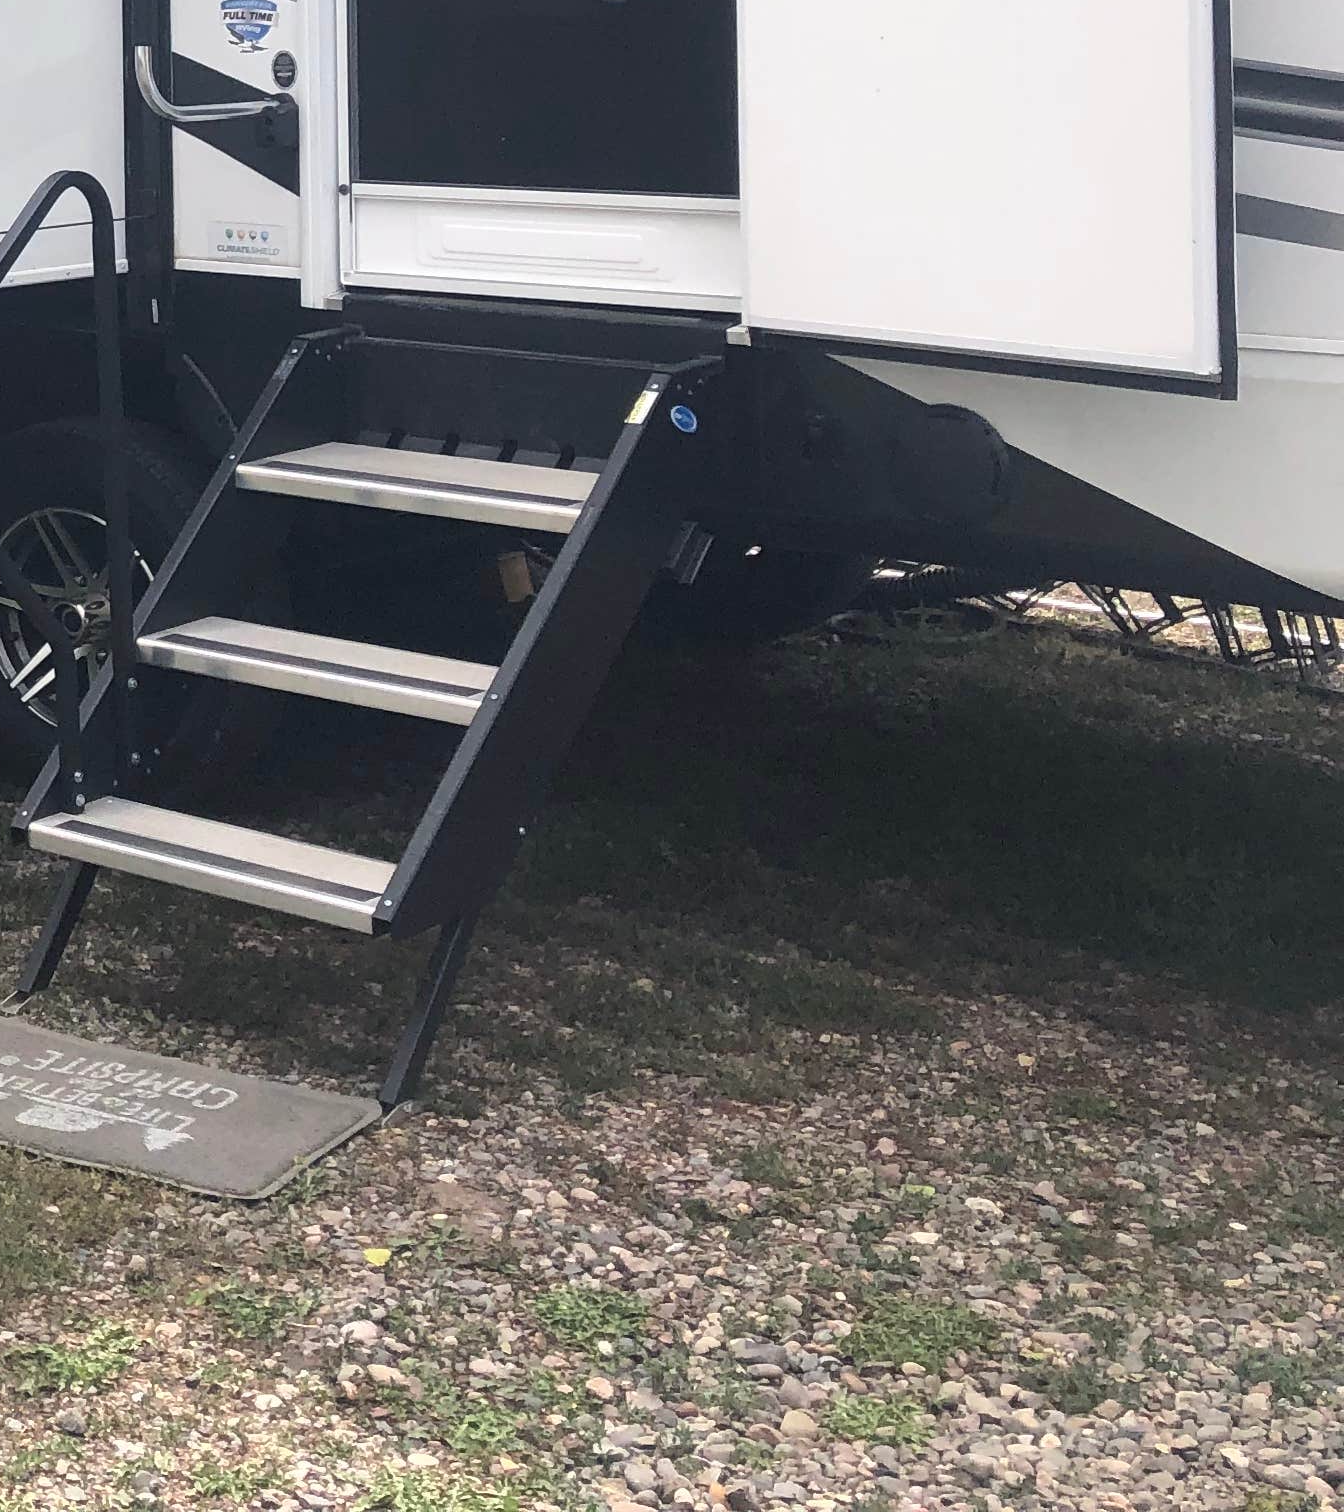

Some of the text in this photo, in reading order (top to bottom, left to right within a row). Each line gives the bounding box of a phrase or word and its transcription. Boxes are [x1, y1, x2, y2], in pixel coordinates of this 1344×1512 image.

[223, 11, 274, 22] FULL TIME
[23, 1049, 239, 1110] CAMPSITE
[125, 1102, 197, 1133] LIFE
